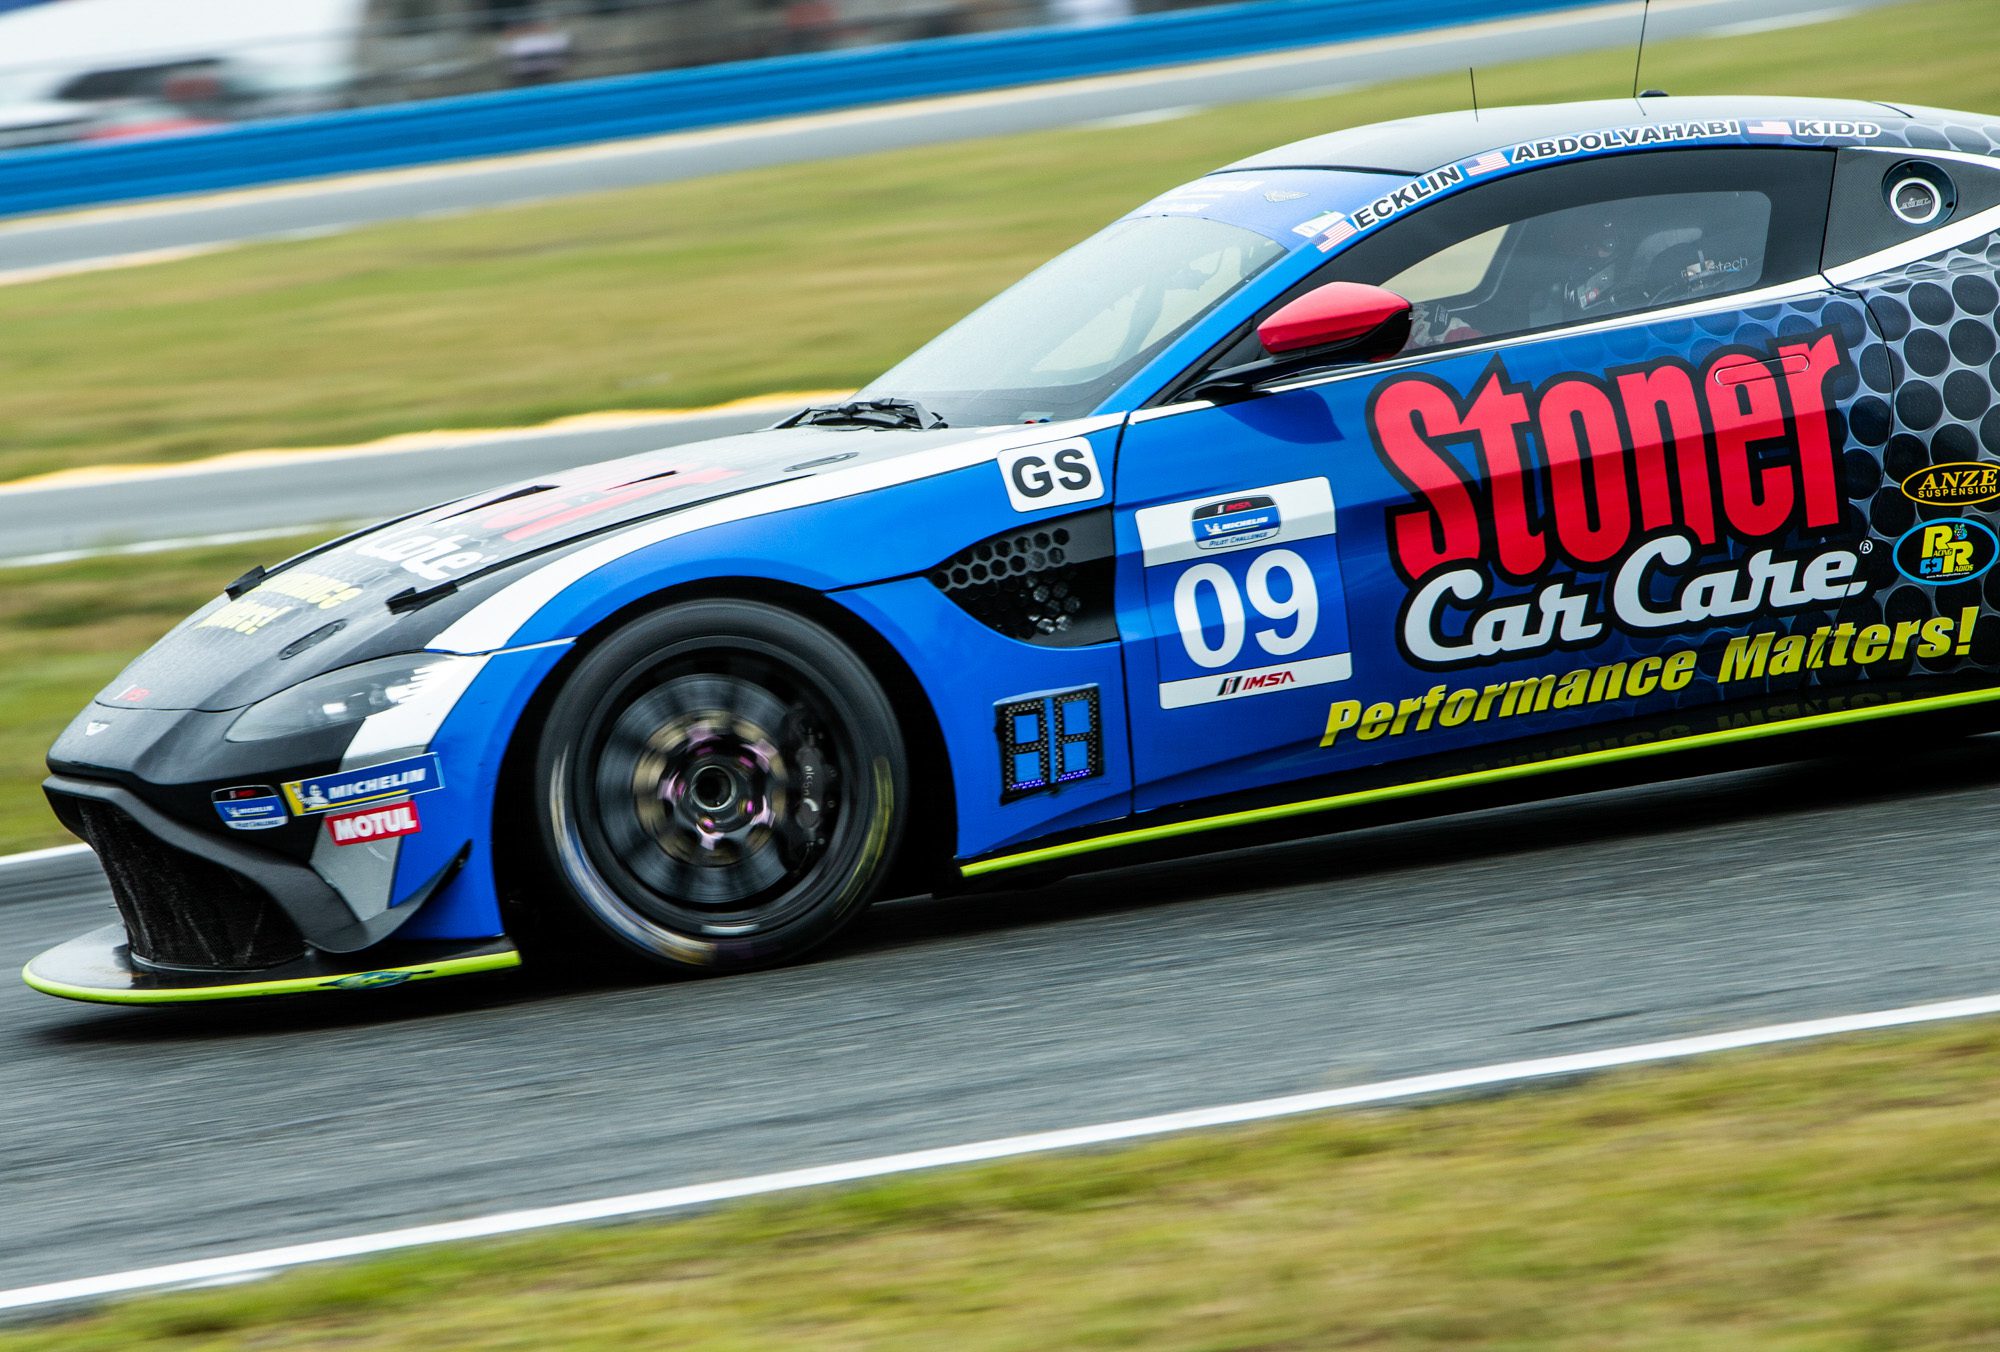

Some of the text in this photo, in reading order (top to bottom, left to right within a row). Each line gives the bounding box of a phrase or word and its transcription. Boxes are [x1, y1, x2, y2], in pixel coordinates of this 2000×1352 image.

[1354, 120, 1878, 229] ECKLIN ABDOLVAHABI KIDD
[1011, 448, 1092, 498] GS
[1374, 333, 1840, 580] Stoner
[1918, 469, 1997, 490] ANZE
[1918, 485, 1996, 498] SUSPENSION
[1173, 548, 1319, 668] 09
[1404, 568, 1602, 662] Car
[1242, 671, 1296, 690] IMSA
[1319, 650, 1697, 747] Performance
[1717, 606, 1980, 684] Matters!
[328, 767, 426, 799] MICHELIN
[333, 807, 417, 841] MOTUL
